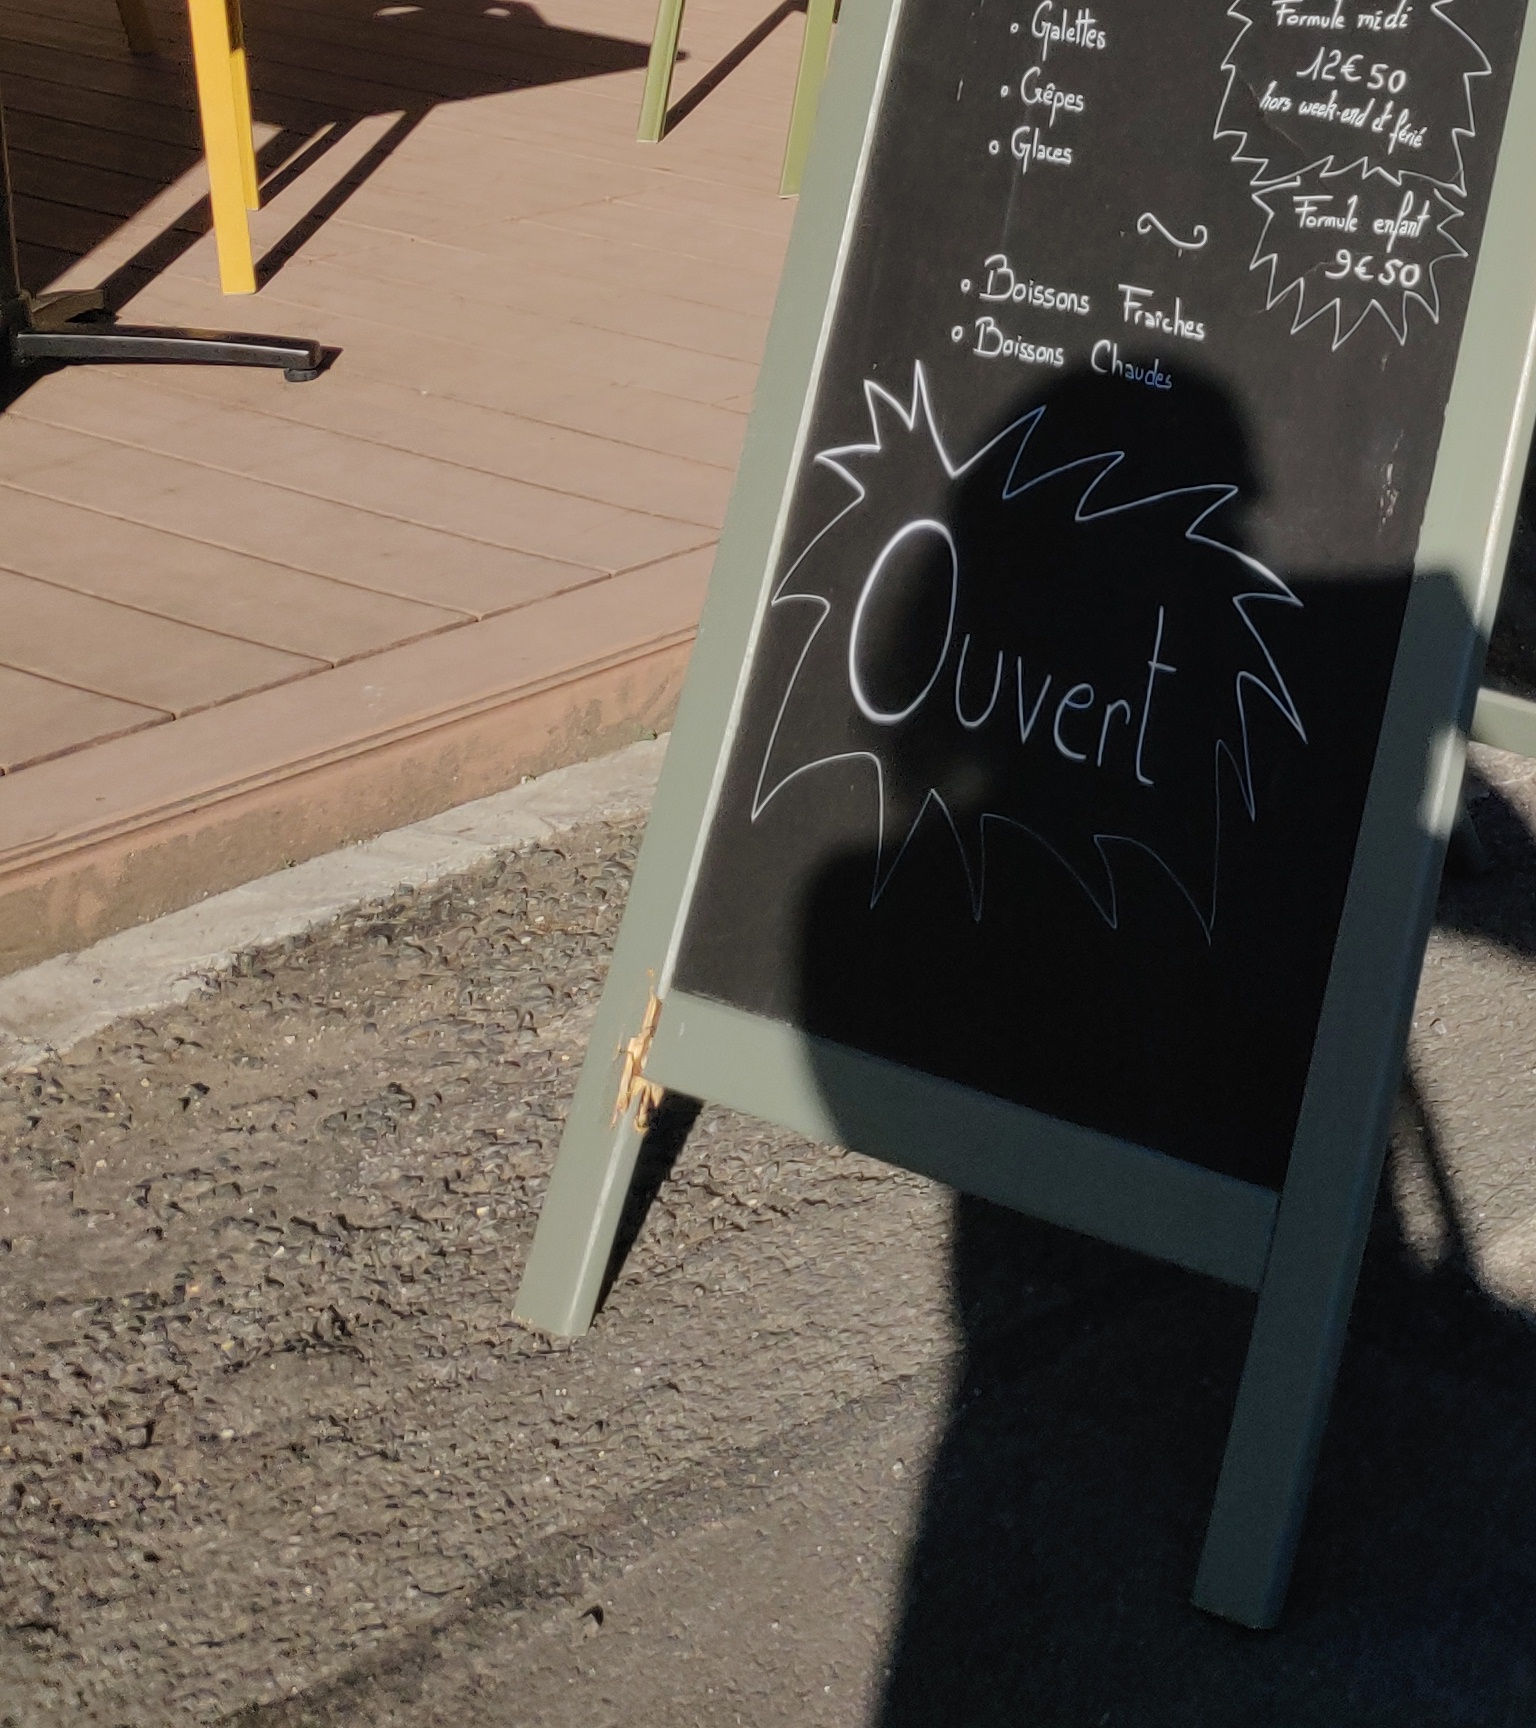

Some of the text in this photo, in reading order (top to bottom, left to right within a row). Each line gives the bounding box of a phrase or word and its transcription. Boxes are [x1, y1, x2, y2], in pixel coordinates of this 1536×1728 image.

[1031, 0, 1107, 62] Galettes
[1259, 80, 1292, 112] hors
[1371, 100, 1394, 133] et
[1010, 125, 1073, 175] Glaces
[1292, 189, 1431, 254] Formule enfant
[978, 253, 1090, 315] Boissons
[972, 315, 1172, 389] Boissons Chaudes
[848, 518, 1177, 786] Ouvert
